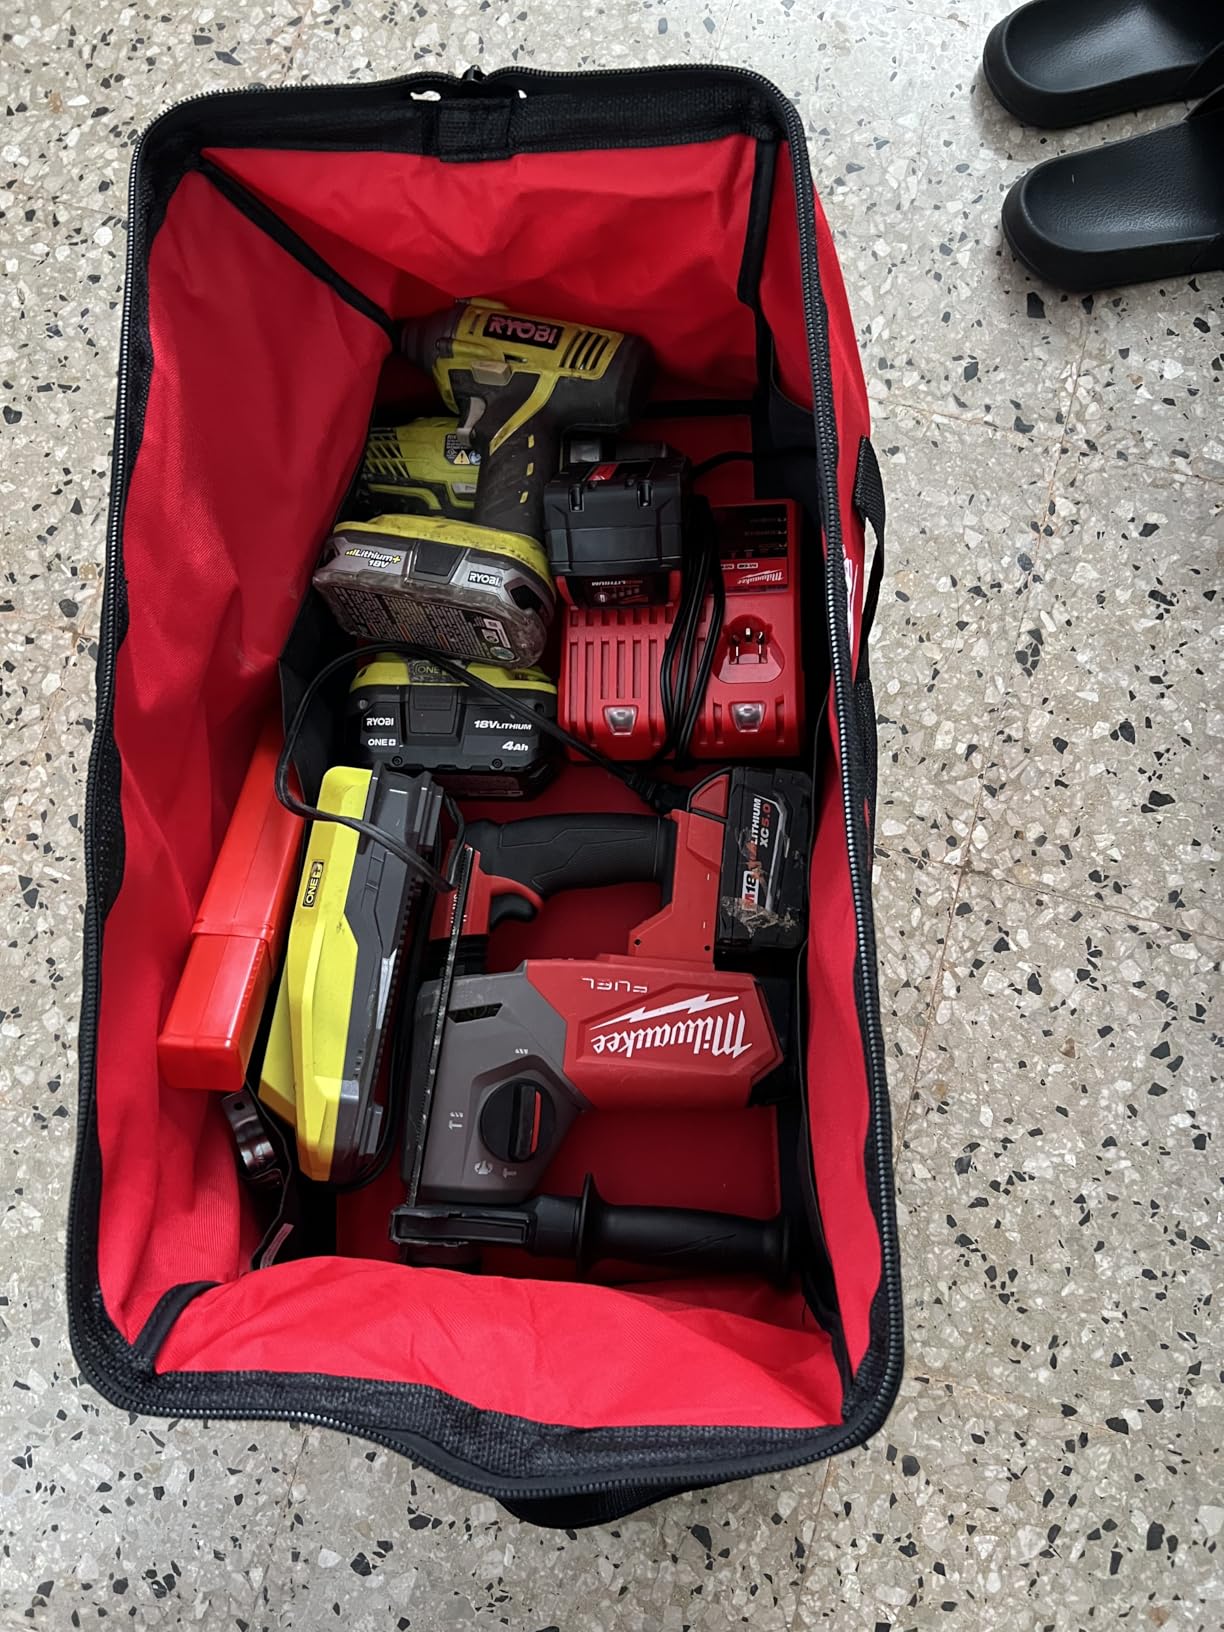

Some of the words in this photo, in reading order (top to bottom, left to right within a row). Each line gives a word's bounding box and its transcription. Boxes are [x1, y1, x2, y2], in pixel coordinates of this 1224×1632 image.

[488, 316, 559, 344] RYOBI
[368, 559, 390, 568] 18V
[469, 572, 500, 586] RYOBI
[366, 717, 394, 726] RYOBI
[502, 740, 529, 752] 4Ah
[582, 977, 648, 993] FUEL
[590, 1010, 753, 1059] Milwaukee
